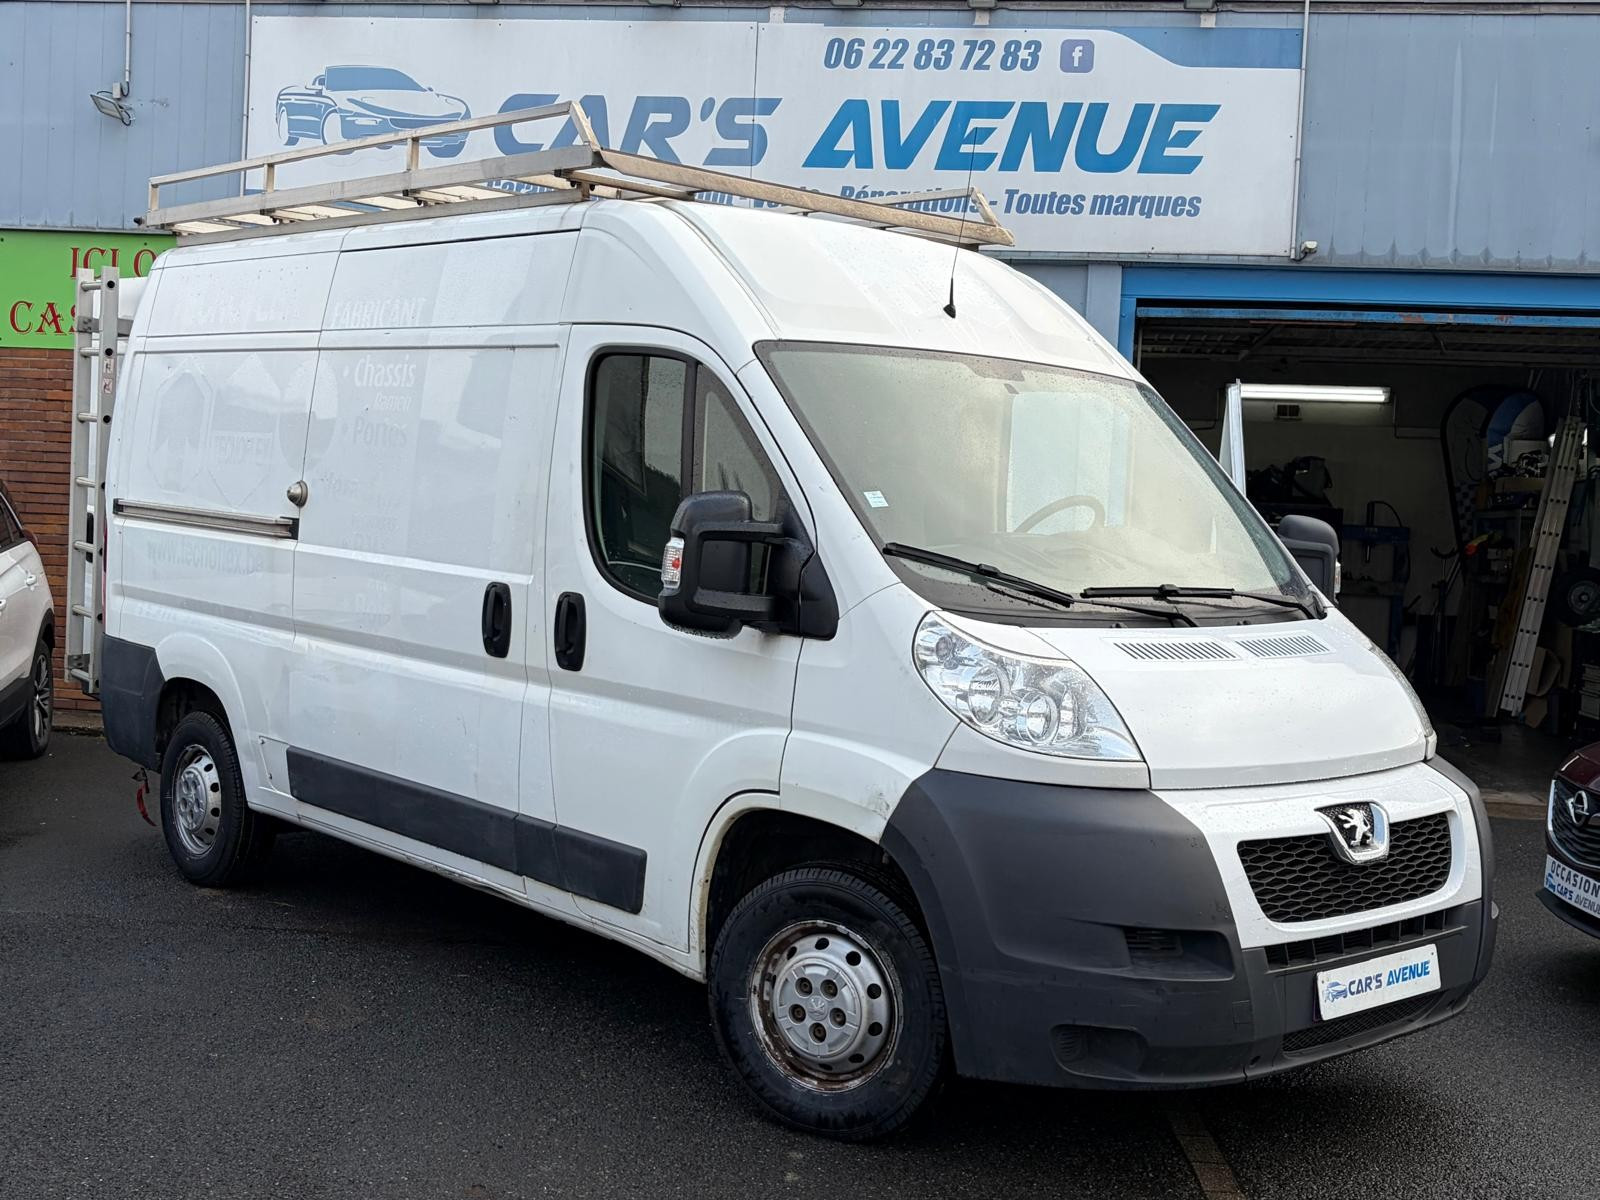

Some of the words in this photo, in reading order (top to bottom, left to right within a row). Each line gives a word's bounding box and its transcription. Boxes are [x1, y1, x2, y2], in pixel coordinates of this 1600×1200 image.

[824, 38, 865, 69] 06
[868, 39, 909, 69] 22
[913, 39, 955, 70] 83
[960, 40, 995, 70] 72
[1000, 40, 1042, 71] 83
[494, 94, 783, 166] CAR'S
[801, 99, 1221, 174] AVENUE
[1004, 189, 1085, 215] Toutes
[1089, 193, 1201, 218] marques
[10, 301, 76, 335] CA
[355, 354, 417, 387] Chassis
[1551, 861, 1600, 898] OCCASION
[1348, 973, 1382, 996] CAR'S
[1386, 960, 1430, 986] AVENUE
